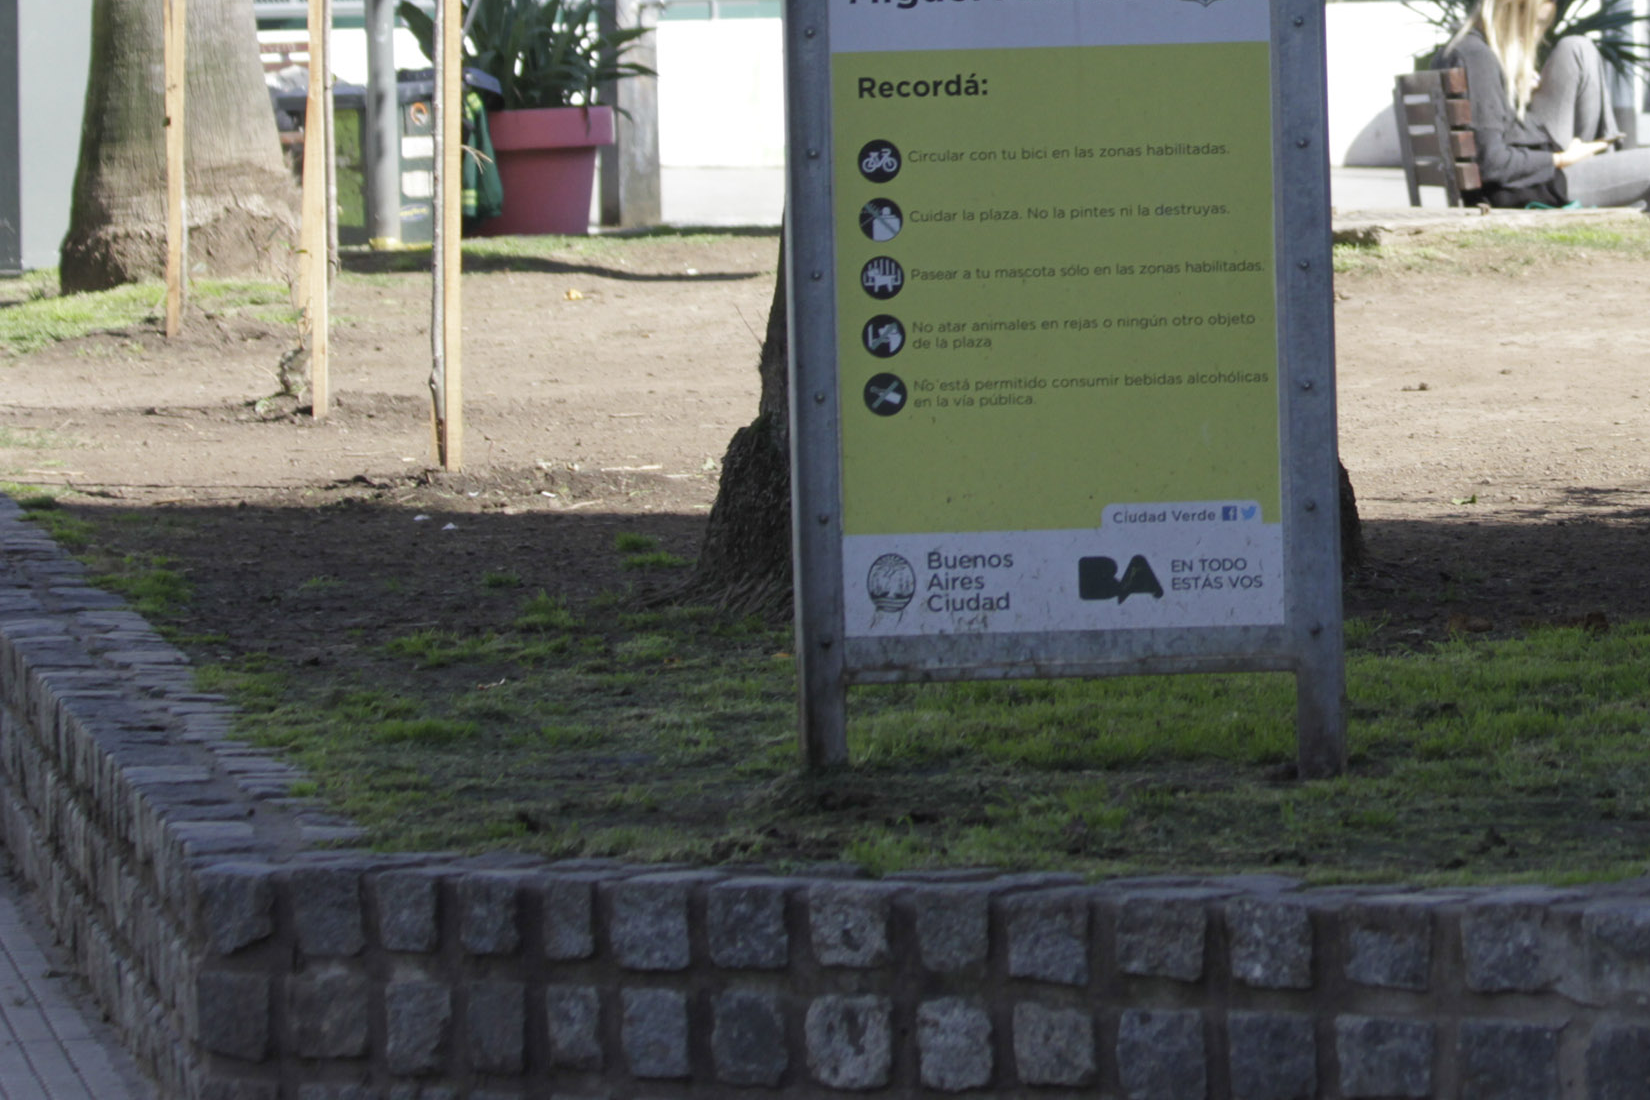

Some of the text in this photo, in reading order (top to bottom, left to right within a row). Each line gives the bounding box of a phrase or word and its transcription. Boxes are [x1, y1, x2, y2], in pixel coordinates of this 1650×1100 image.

[858, 74, 989, 99] Recordá:
[907, 142, 1230, 163] Circular con tu bici en las zonas habilitadas.
[909, 203, 1230, 223] Cuidar la plaza. No la pintes ni la destruyas.
[911, 259, 1265, 281] Pasear a tu mascota sólo en las zonas habilitadas.
[912, 311, 1256, 333] No atar animales en rejas o ningún otro objeto
[912, 336, 992, 352] de la plaza
[914, 369, 1269, 392] No está permitido consumir bebidas alcohólicas
[914, 392, 1037, 409] en la vía pública.
[1112, 508, 1216, 525] Ciudad Verde
[927, 550, 1014, 571] Buenos
[1171, 558, 1247, 573] EN TODO
[926, 572, 985, 591] Aires
[1171, 574, 1263, 590] ESTÁS VOS
[926, 592, 1010, 613] Ciudad
